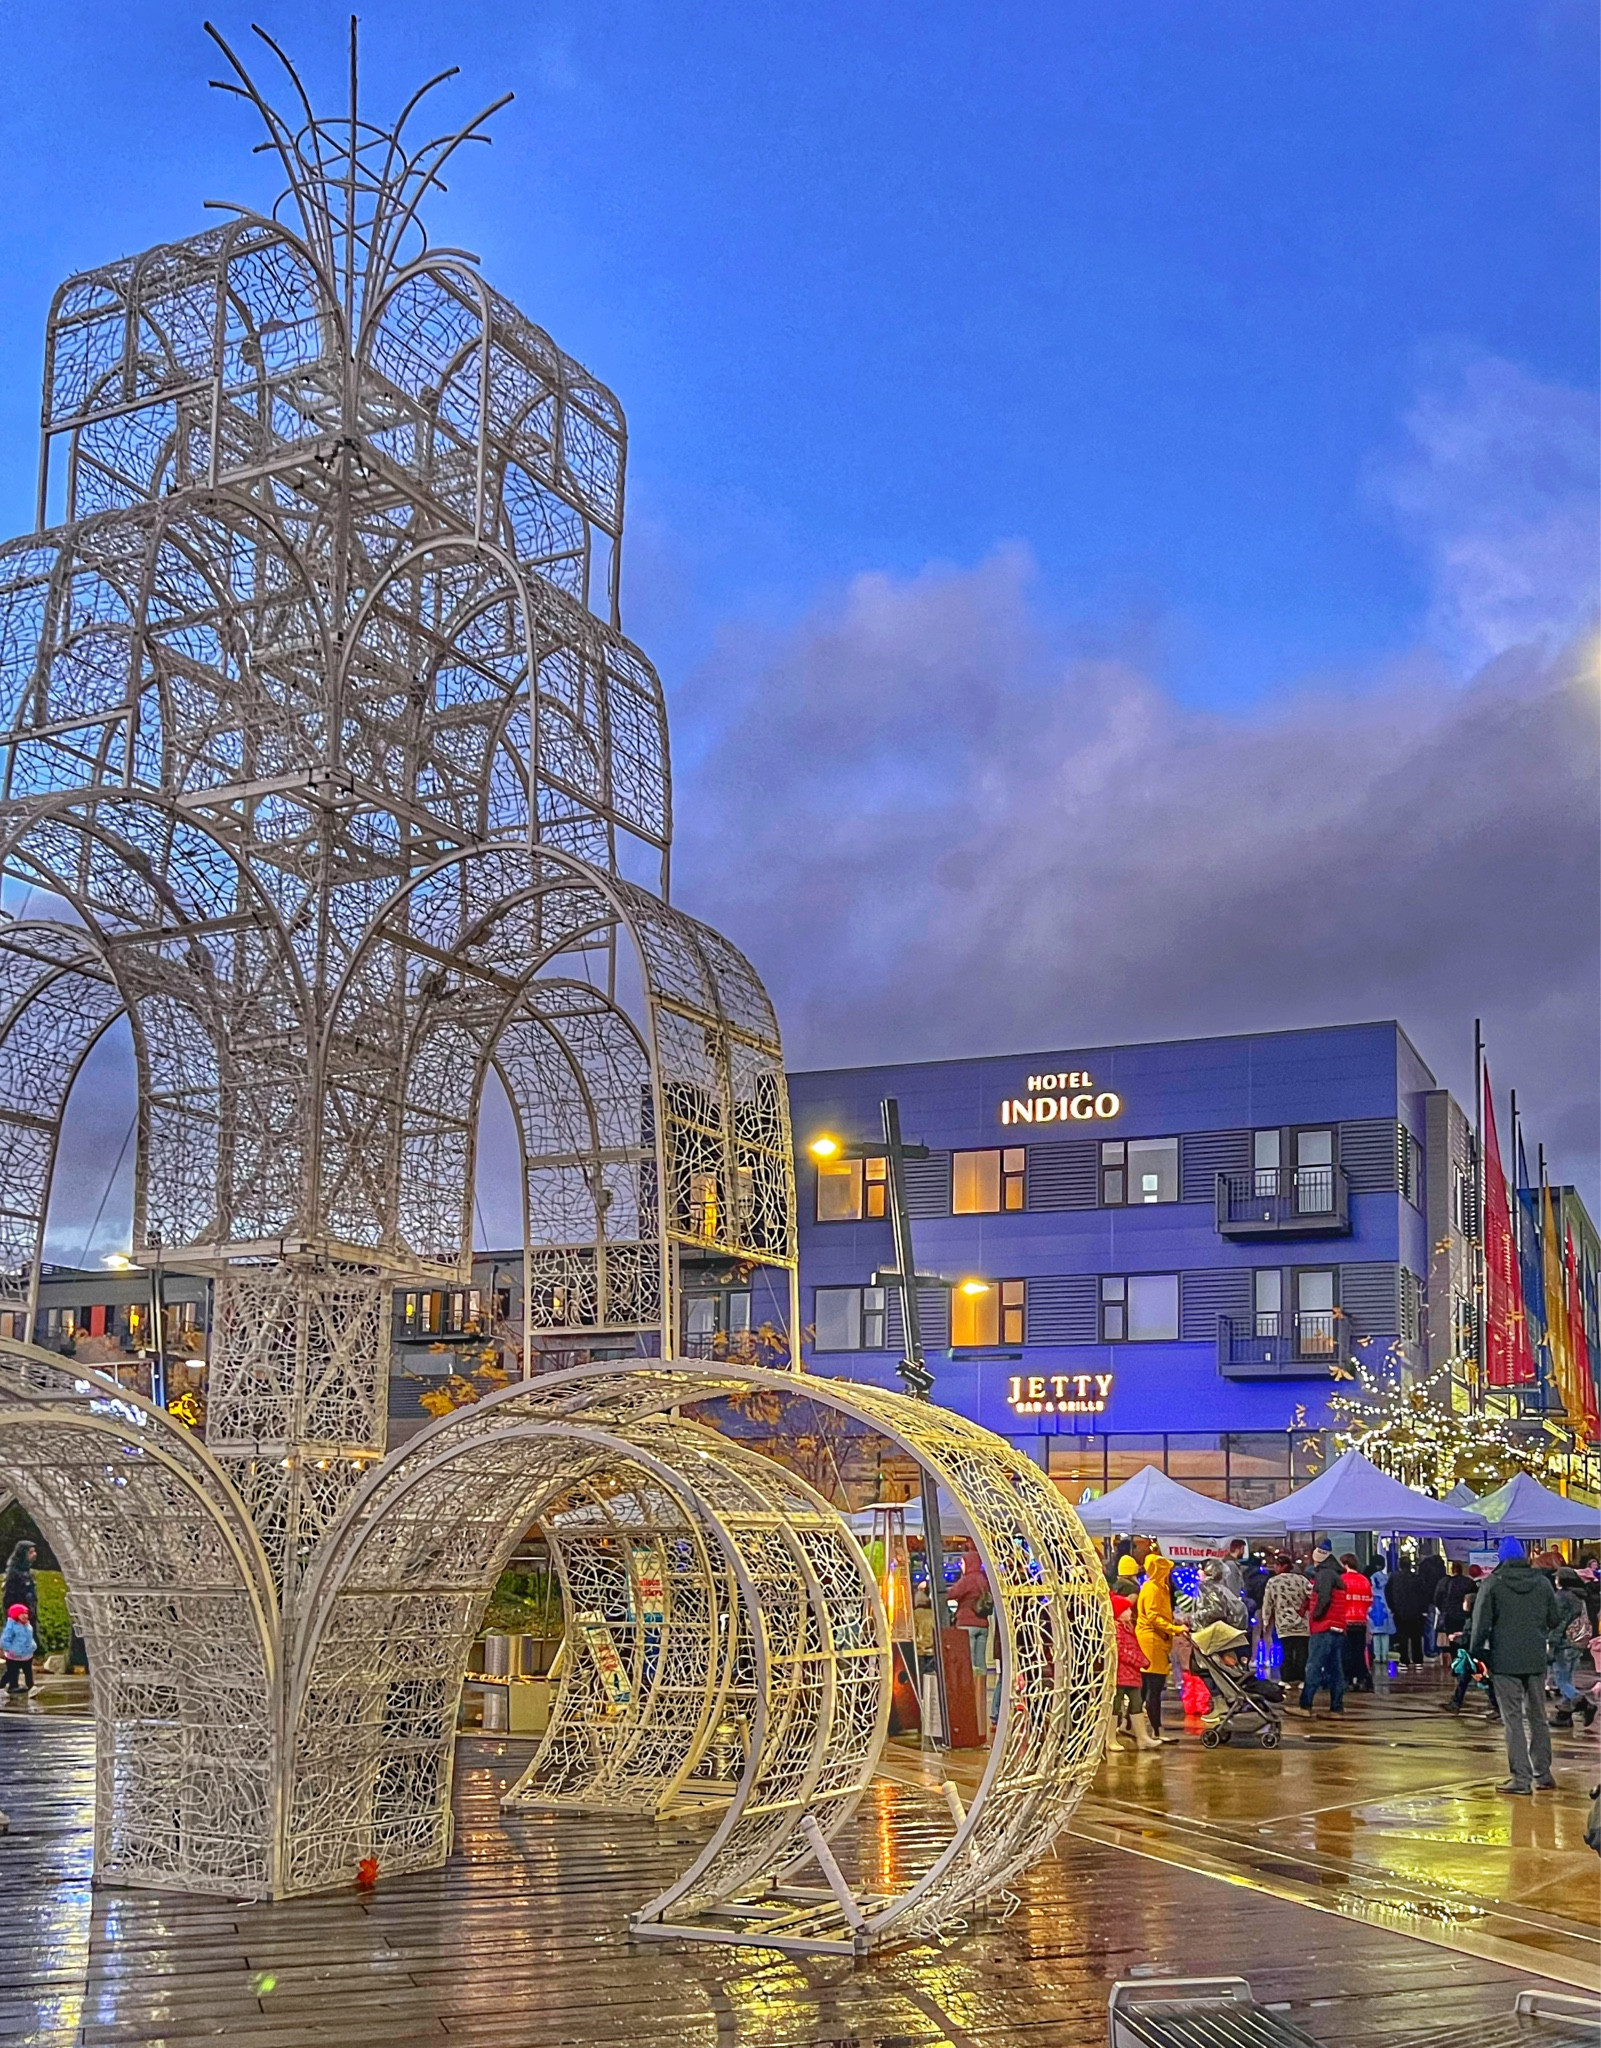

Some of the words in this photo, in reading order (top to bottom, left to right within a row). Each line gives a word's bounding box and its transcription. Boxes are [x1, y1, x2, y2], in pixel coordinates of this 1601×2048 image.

[1027, 1071, 1093, 1091] HOTEL
[1002, 1092, 1120, 1125] INDIGO
[1007, 1374, 1113, 1403] JETTY
[1169, 1546, 1188, 1556] FREE
